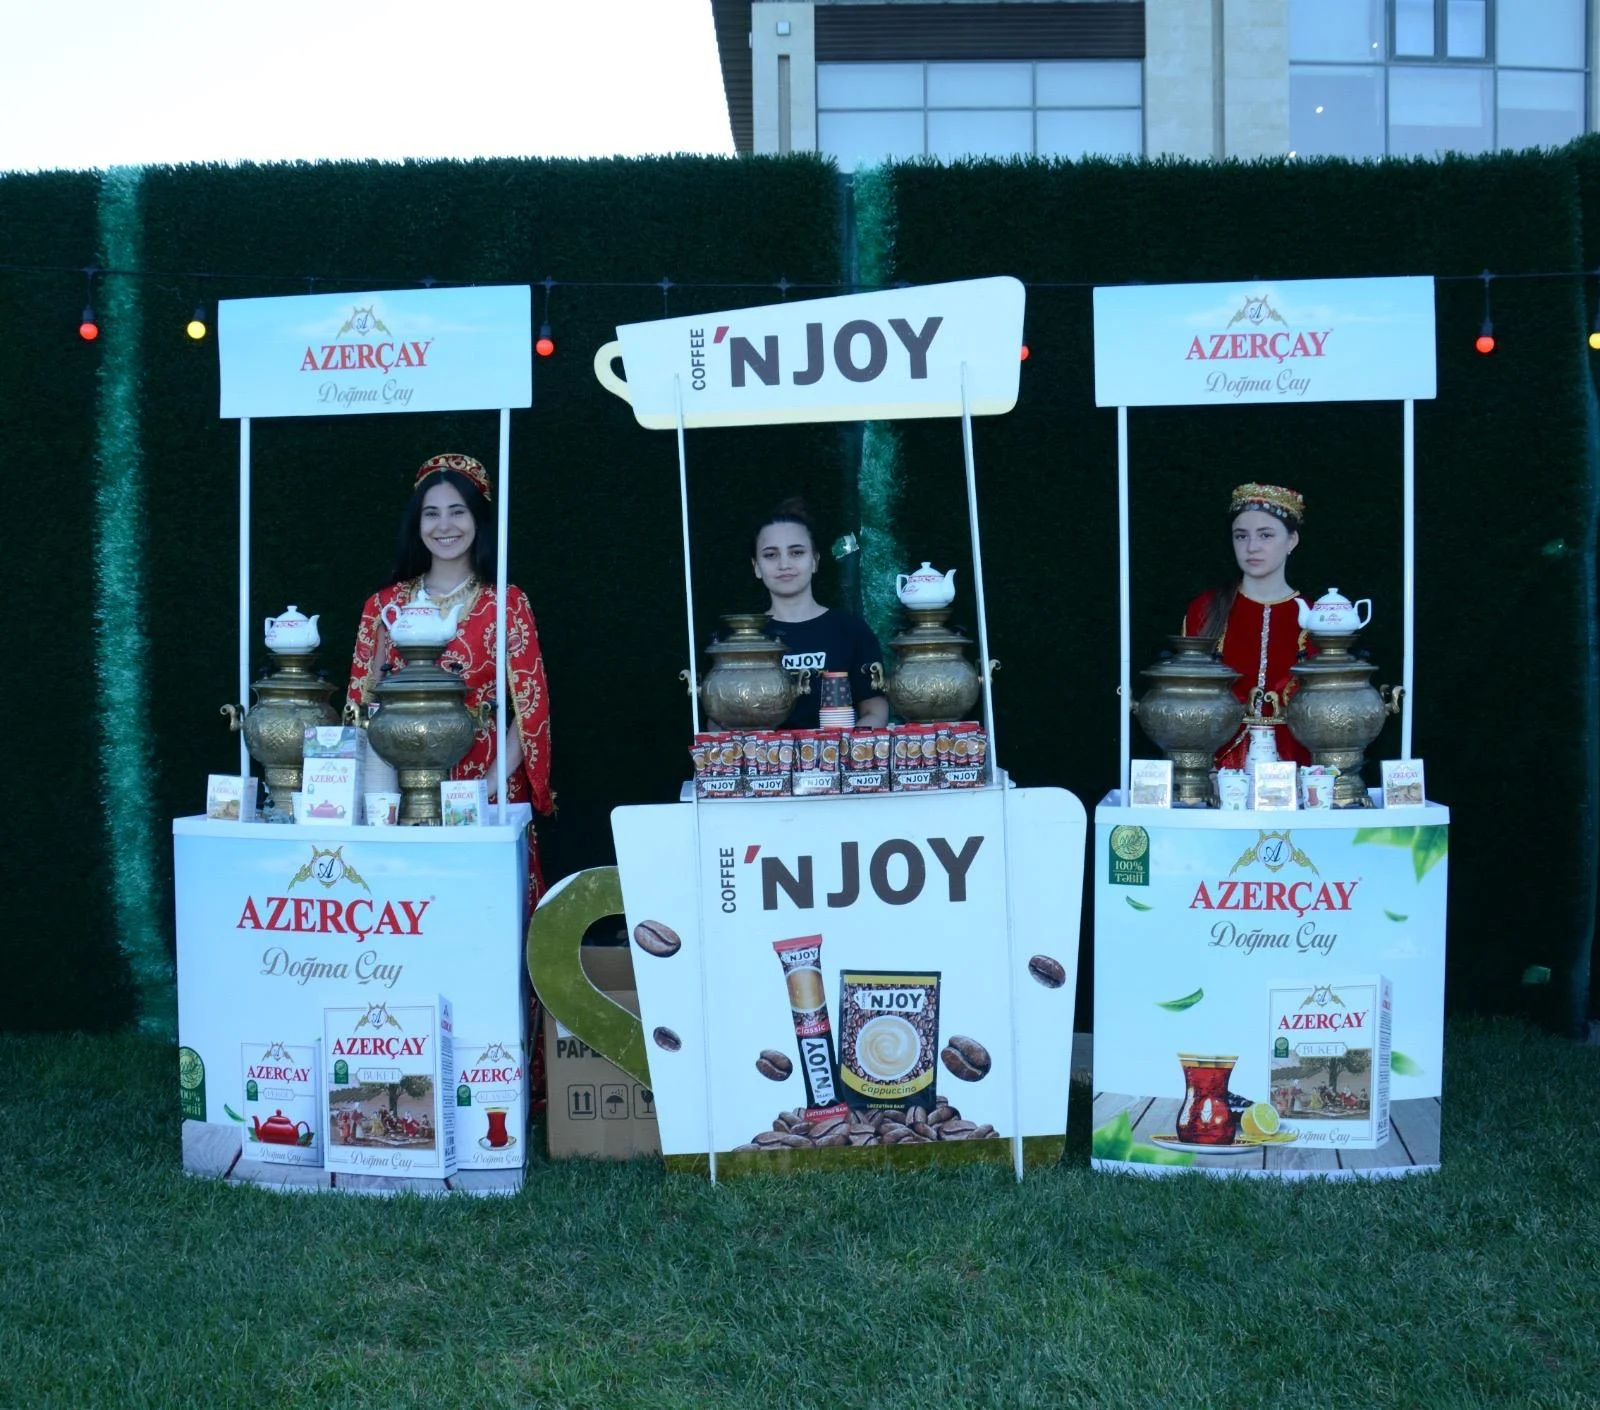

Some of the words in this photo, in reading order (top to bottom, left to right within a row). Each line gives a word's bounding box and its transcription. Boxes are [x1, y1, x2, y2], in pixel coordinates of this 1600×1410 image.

[300, 341, 431, 374] AZERÇAY
[1185, 331, 1330, 364] AZERÇAY
[690, 328, 706, 391] COFFEE
[317, 381, 378, 408] Doğma
[381, 378, 414, 406] Çay
[1205, 370, 1272, 399] Doğma
[1276, 368, 1312, 397] Çay
[784, 655, 824, 668] NJOY
[1115, 860, 1143, 871] 100%
[719, 847, 736, 913] COFFEE
[1188, 879, 1358, 918] AZERÇAY
[236, 895, 430, 942] AZERÇAY
[1207, 920, 1290, 955] Doğma
[1295, 921, 1338, 957] Çay
[259, 946, 349, 986] Doğma
[355, 950, 403, 989] Çay
[1278, 1011, 1368, 1032] AZERÇAY
[331, 1036, 427, 1060] AZERÇAY
[556, 1039, 602, 1059] PAP
[1303, 1045, 1339, 1055] BUKET
[247, 1065, 310, 1083] AZERÇAY
[363, 1070, 397, 1081] BUKET
[459, 1067, 523, 1085] AZERÇA
[861, 1083, 917, 1096] Cappuccino
[1328, 1127, 1351, 1144] Çay
[350, 1150, 389, 1168] Doğma
[391, 1151, 413, 1171] Çay
